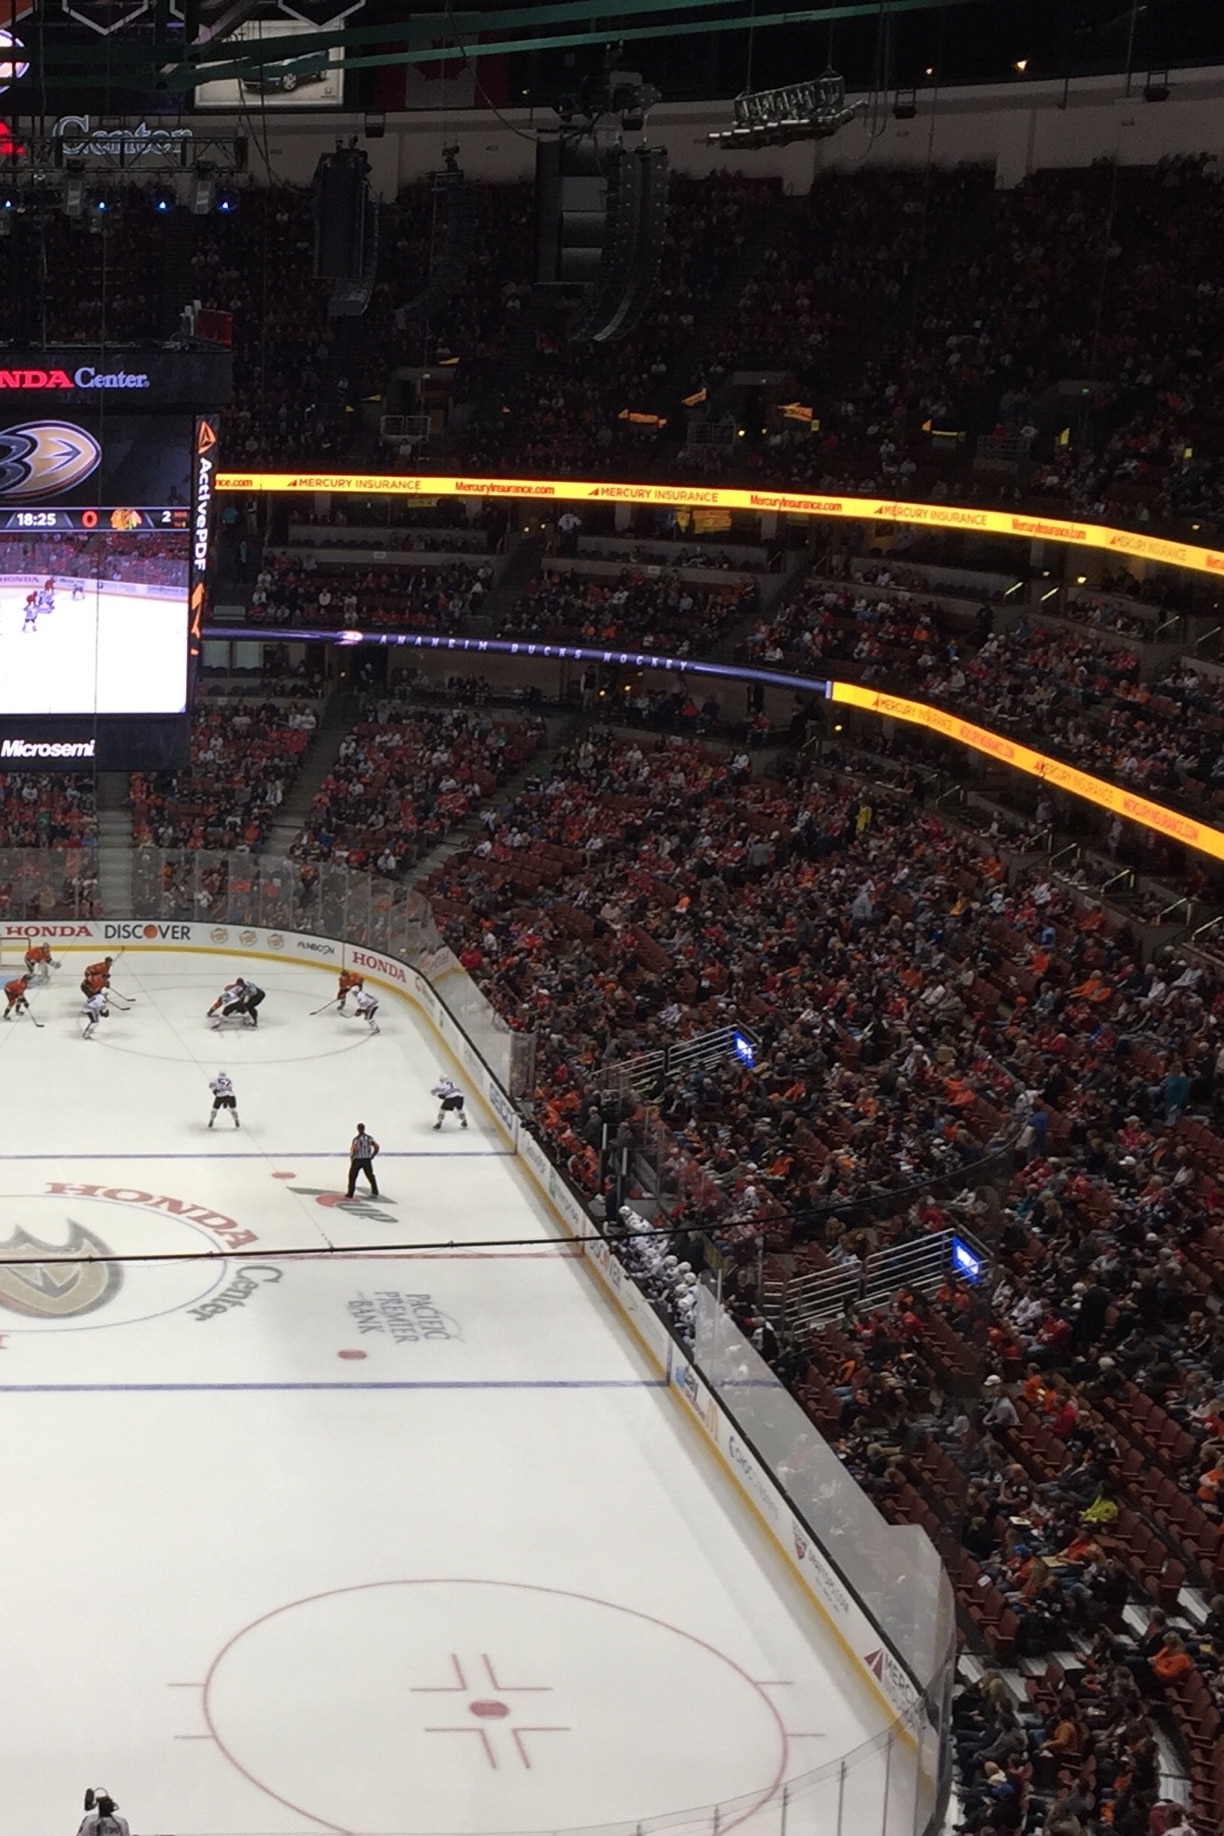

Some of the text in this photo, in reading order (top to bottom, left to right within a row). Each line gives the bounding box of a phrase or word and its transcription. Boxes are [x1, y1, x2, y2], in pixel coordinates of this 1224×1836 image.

[55, 115, 192, 155] Center
[75, 367, 147, 388] Center
[299, 479, 421, 490] MERCURY INSURANCE
[601, 487, 718, 502] MERCURY INSURANCE
[16, 512, 56, 526] 18:25
[82, 511, 98, 528] 0
[162, 511, 171, 523] 2
[194, 458, 212, 570] ActivePDF
[884, 505, 987, 525] MERCURY INSURANCE
[380, 635, 687, 671] ANAHEIM DUCKS HOCKEY
[1, 739, 95, 757] Microsemi
[5, 925, 93, 937] HONDA
[105, 924, 191, 940] DISCOVER
[352, 951, 408, 983] HONDA
[45, 1182, 260, 1250] HONDA
[187, 1265, 283, 1322] Center
[349, 1299, 385, 1334] BANK
[375, 1291, 419, 1344] PREMIER
[406, 1293, 451, 1341] PACIFIC
